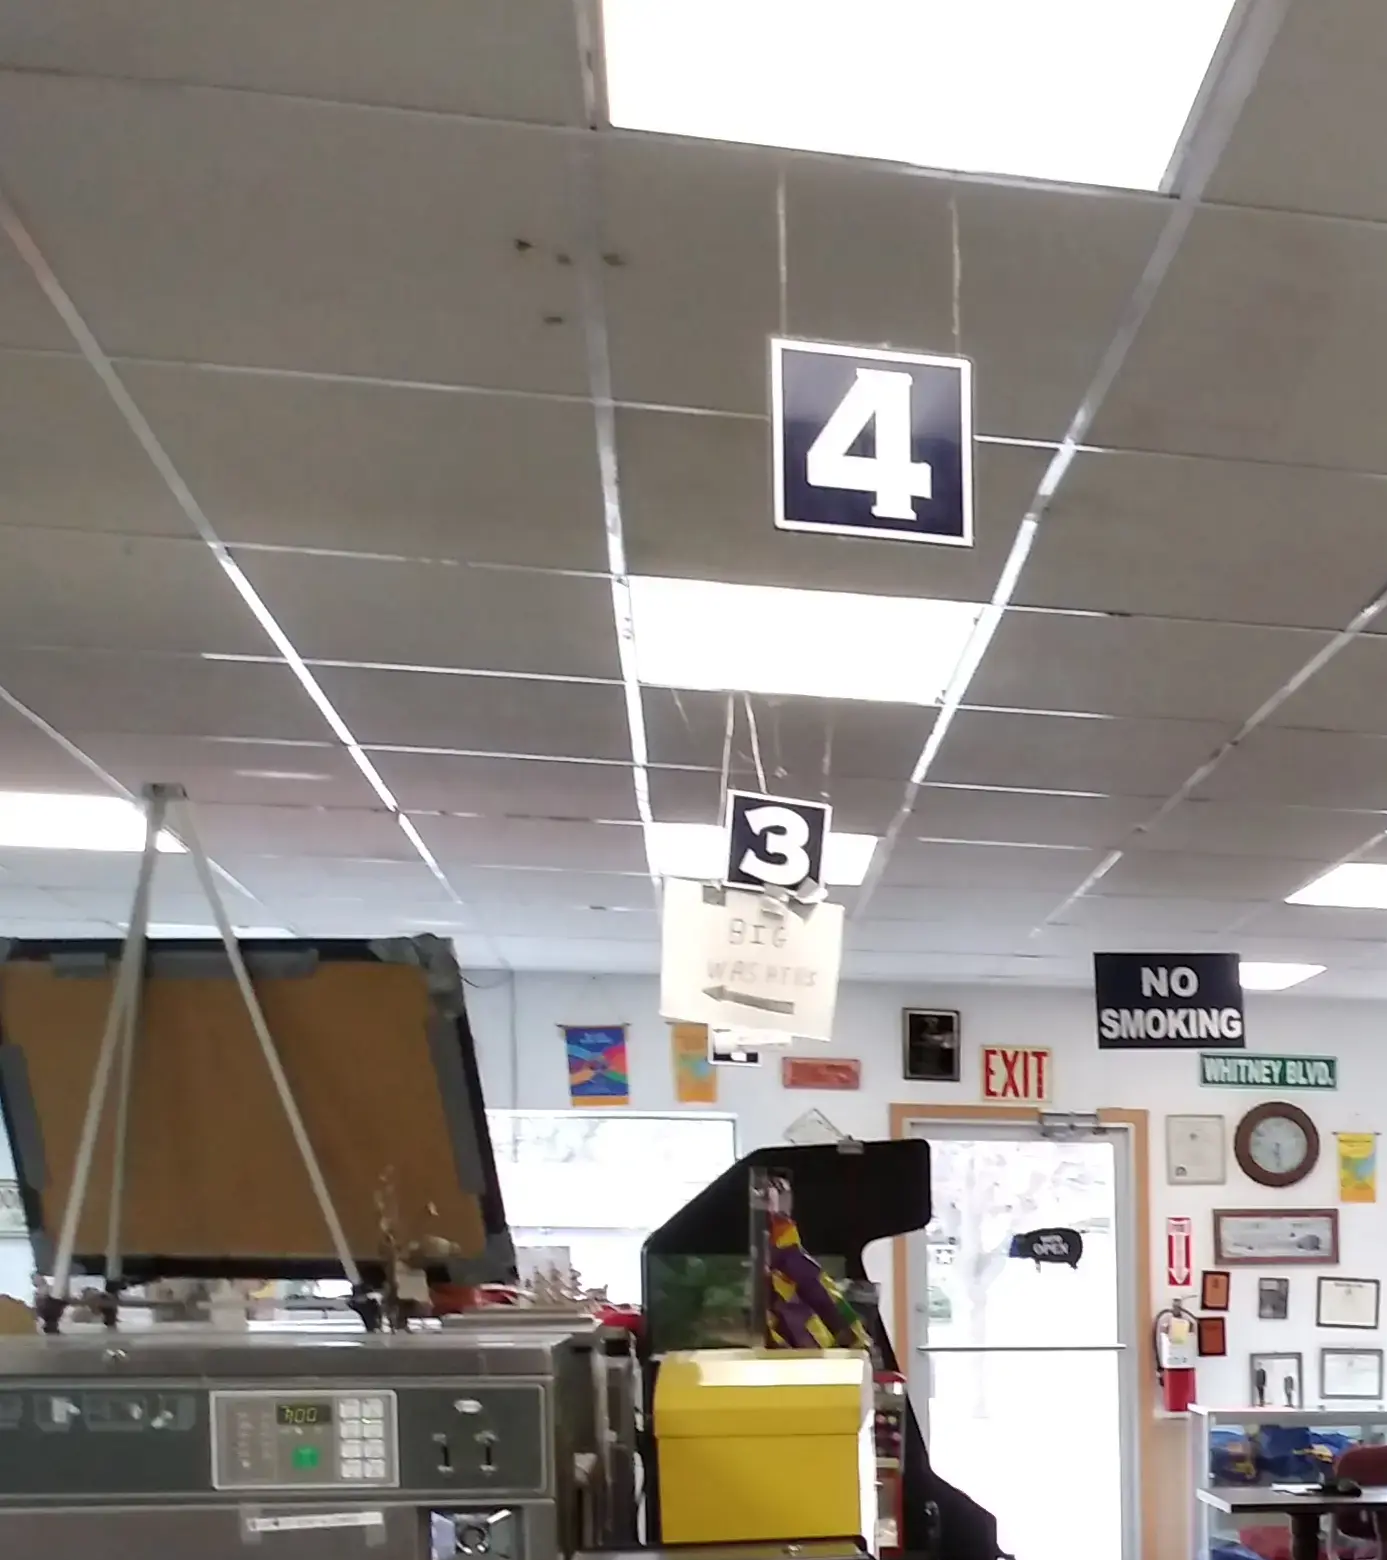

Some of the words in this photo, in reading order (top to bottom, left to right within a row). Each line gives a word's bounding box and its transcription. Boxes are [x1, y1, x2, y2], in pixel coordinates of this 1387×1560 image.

[807, 367, 933, 521] 4
[738, 805, 811, 886] 3
[729, 917, 788, 949] BIG
[1141, 966, 1199, 998] NO
[1100, 1007, 1243, 1041] SMOKING
[984, 1049, 1048, 1100] EXIT
[1204, 1055, 1283, 1085] WHITNEY
